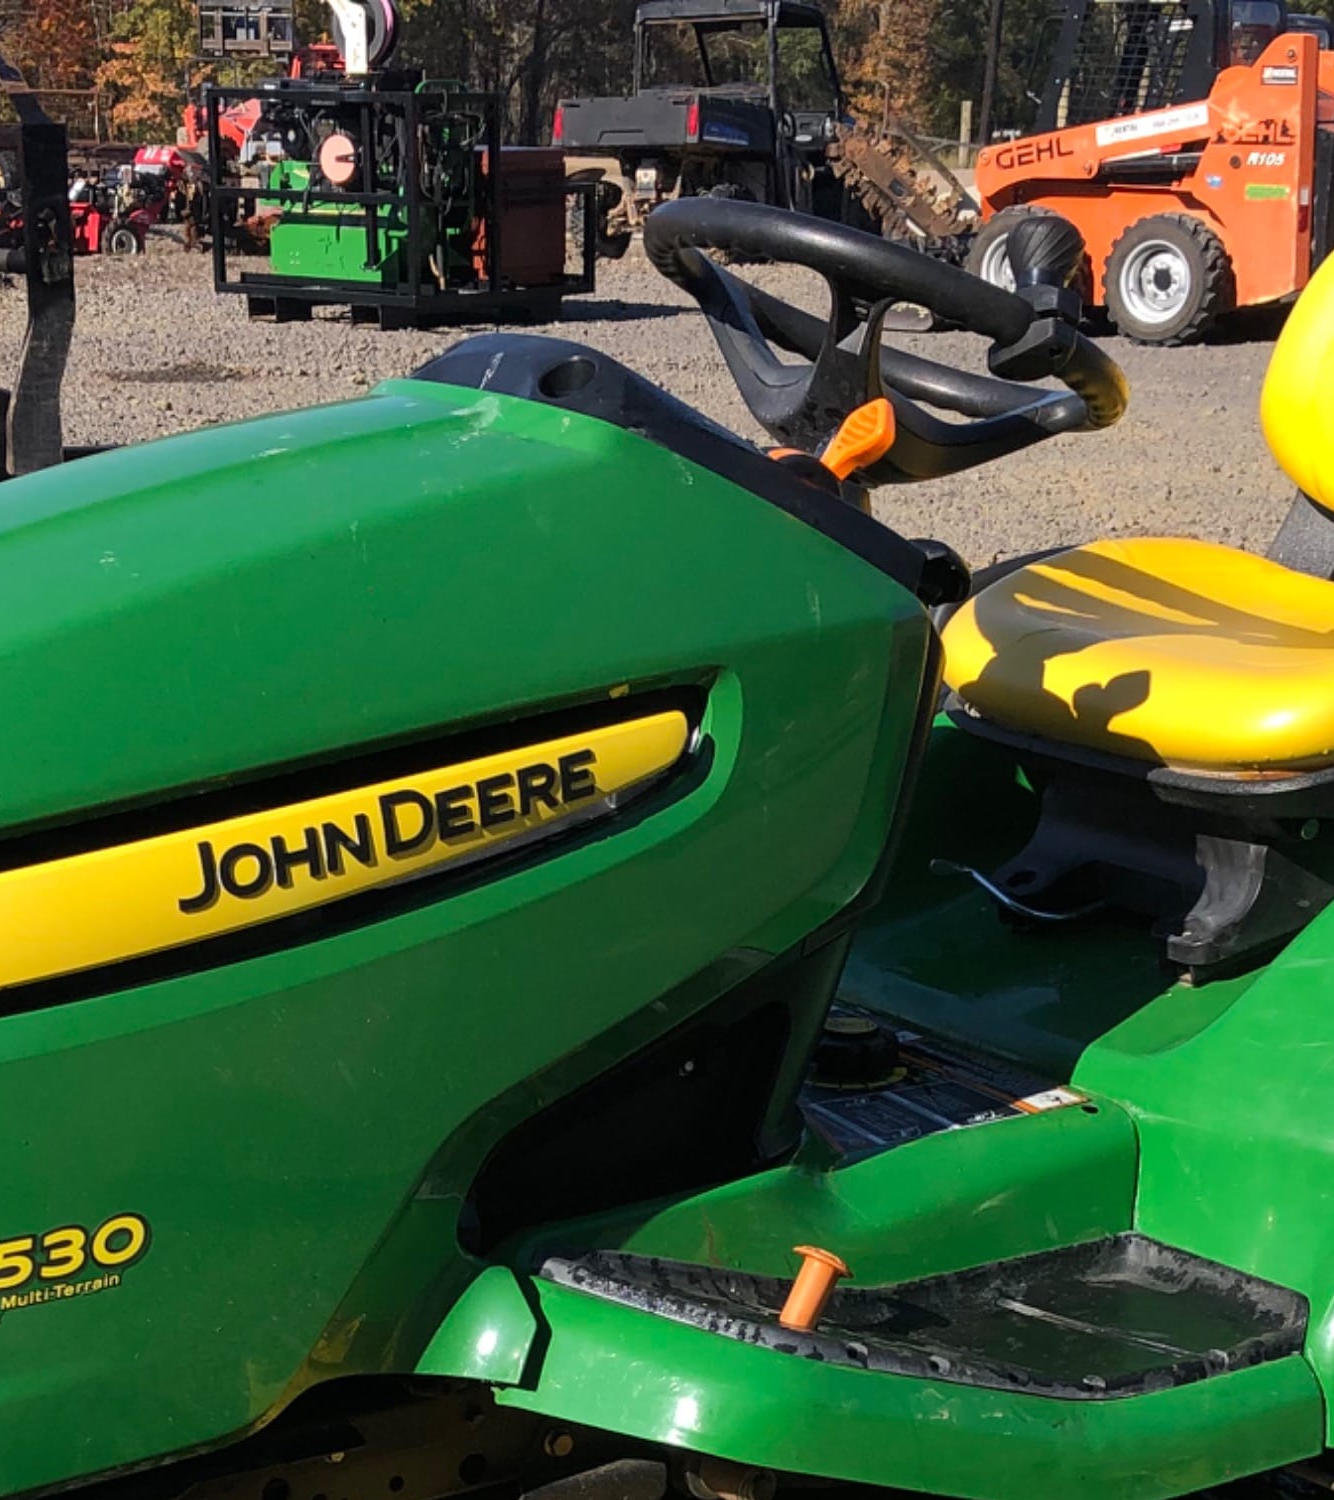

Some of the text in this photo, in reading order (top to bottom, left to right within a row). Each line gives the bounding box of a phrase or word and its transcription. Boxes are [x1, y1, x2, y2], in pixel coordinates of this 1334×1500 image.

[995, 138, 1074, 170] GEHL
[178, 749, 597, 914] JOHN DEERE
[0, 1272, 120, 1310] Multi-Terrain
